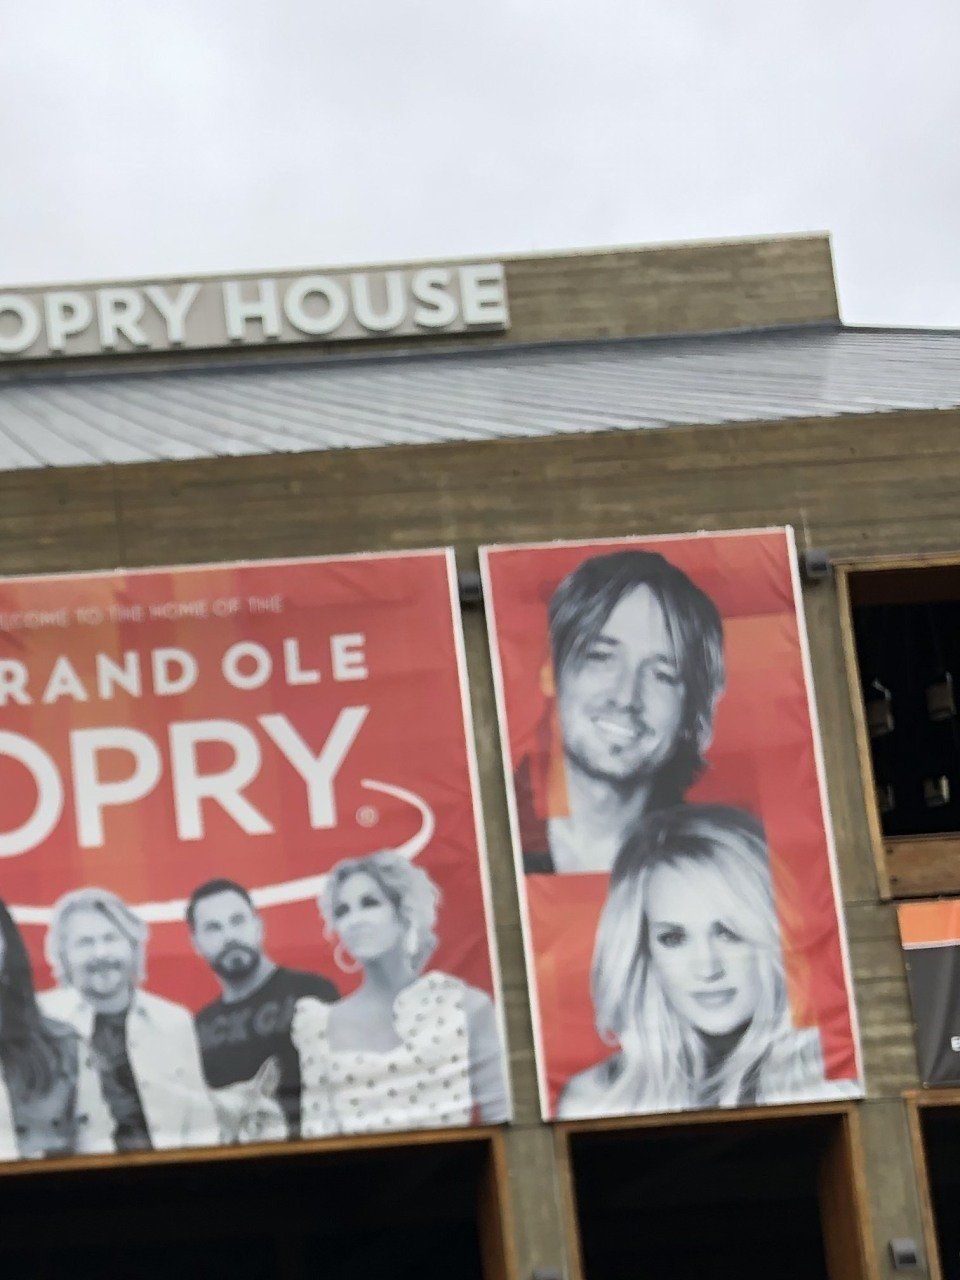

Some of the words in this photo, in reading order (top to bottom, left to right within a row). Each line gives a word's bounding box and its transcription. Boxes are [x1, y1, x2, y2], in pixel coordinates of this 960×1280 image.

[223, 262, 509, 342] HOUSE
[77, 608, 104, 627] TO
[150, 600, 208, 620] HOME
[249, 595, 283, 614] THE
[221, 634, 368, 690] OLE
